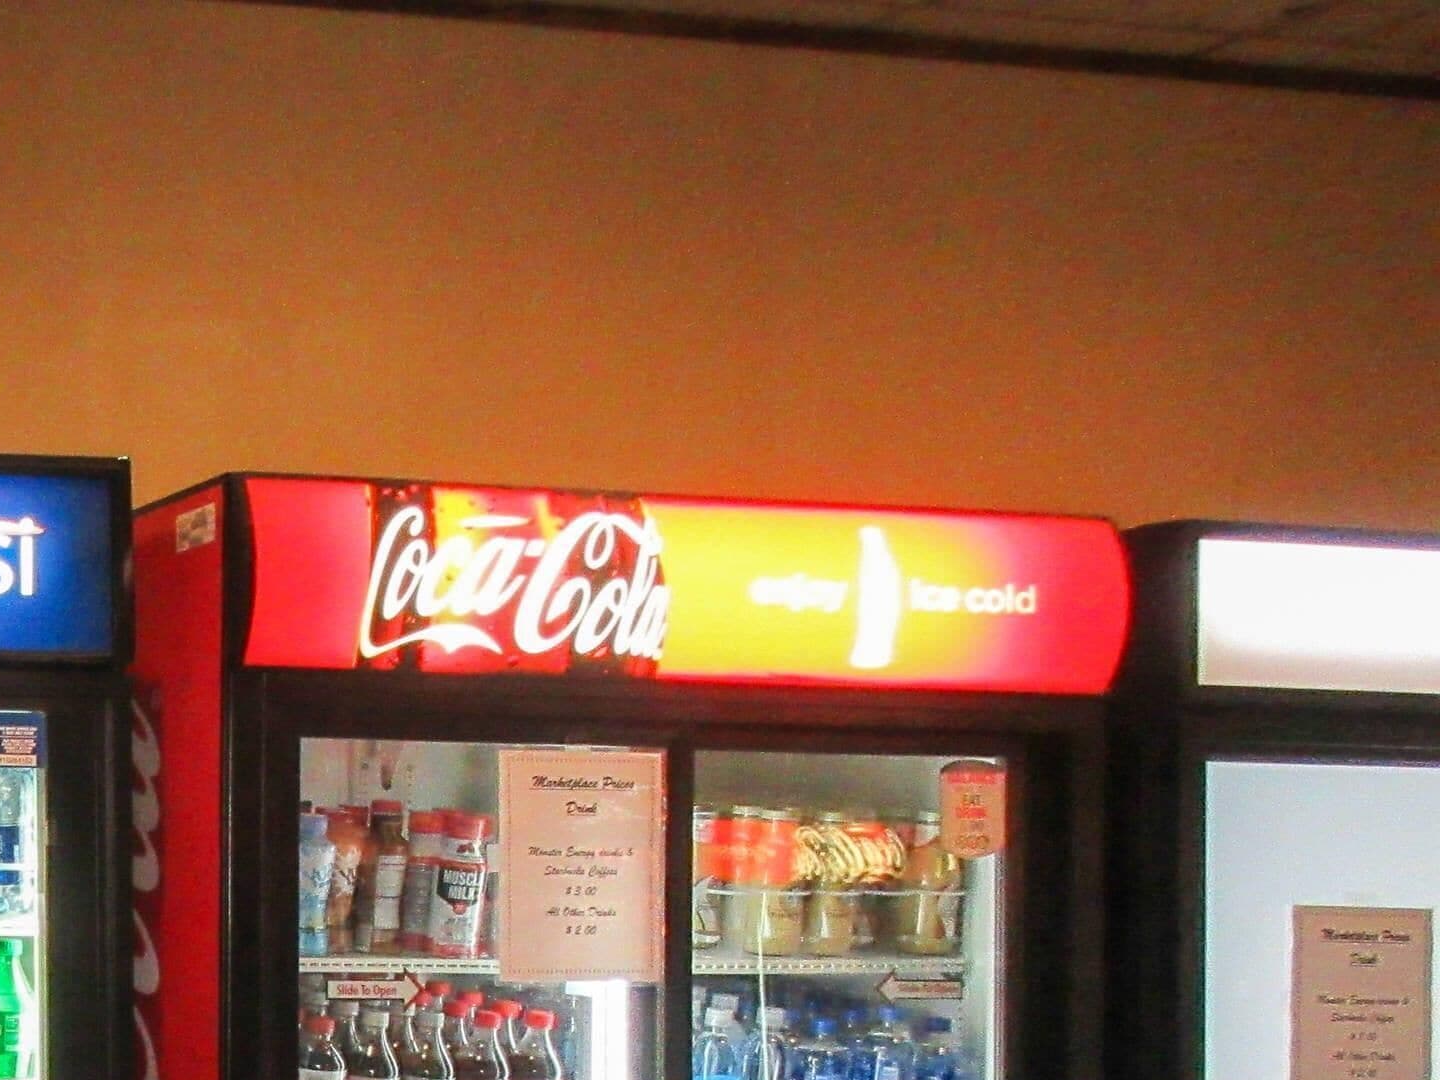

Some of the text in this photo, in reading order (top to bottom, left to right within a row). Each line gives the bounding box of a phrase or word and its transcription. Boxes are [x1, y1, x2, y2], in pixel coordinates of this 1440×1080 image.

[360, 506, 670, 659] Coca-Cola
[909, 578, 959, 612] ice
[964, 583, 1036, 614] cold
[531, 775, 636, 791] Marketplace Prices
[565, 801, 598, 815] Drink
[528, 846, 562, 858] Monster
[565, 846, 596, 860] Energy
[448, 885, 477, 901] MILK
[336, 984, 398, 997] Slide To Open
